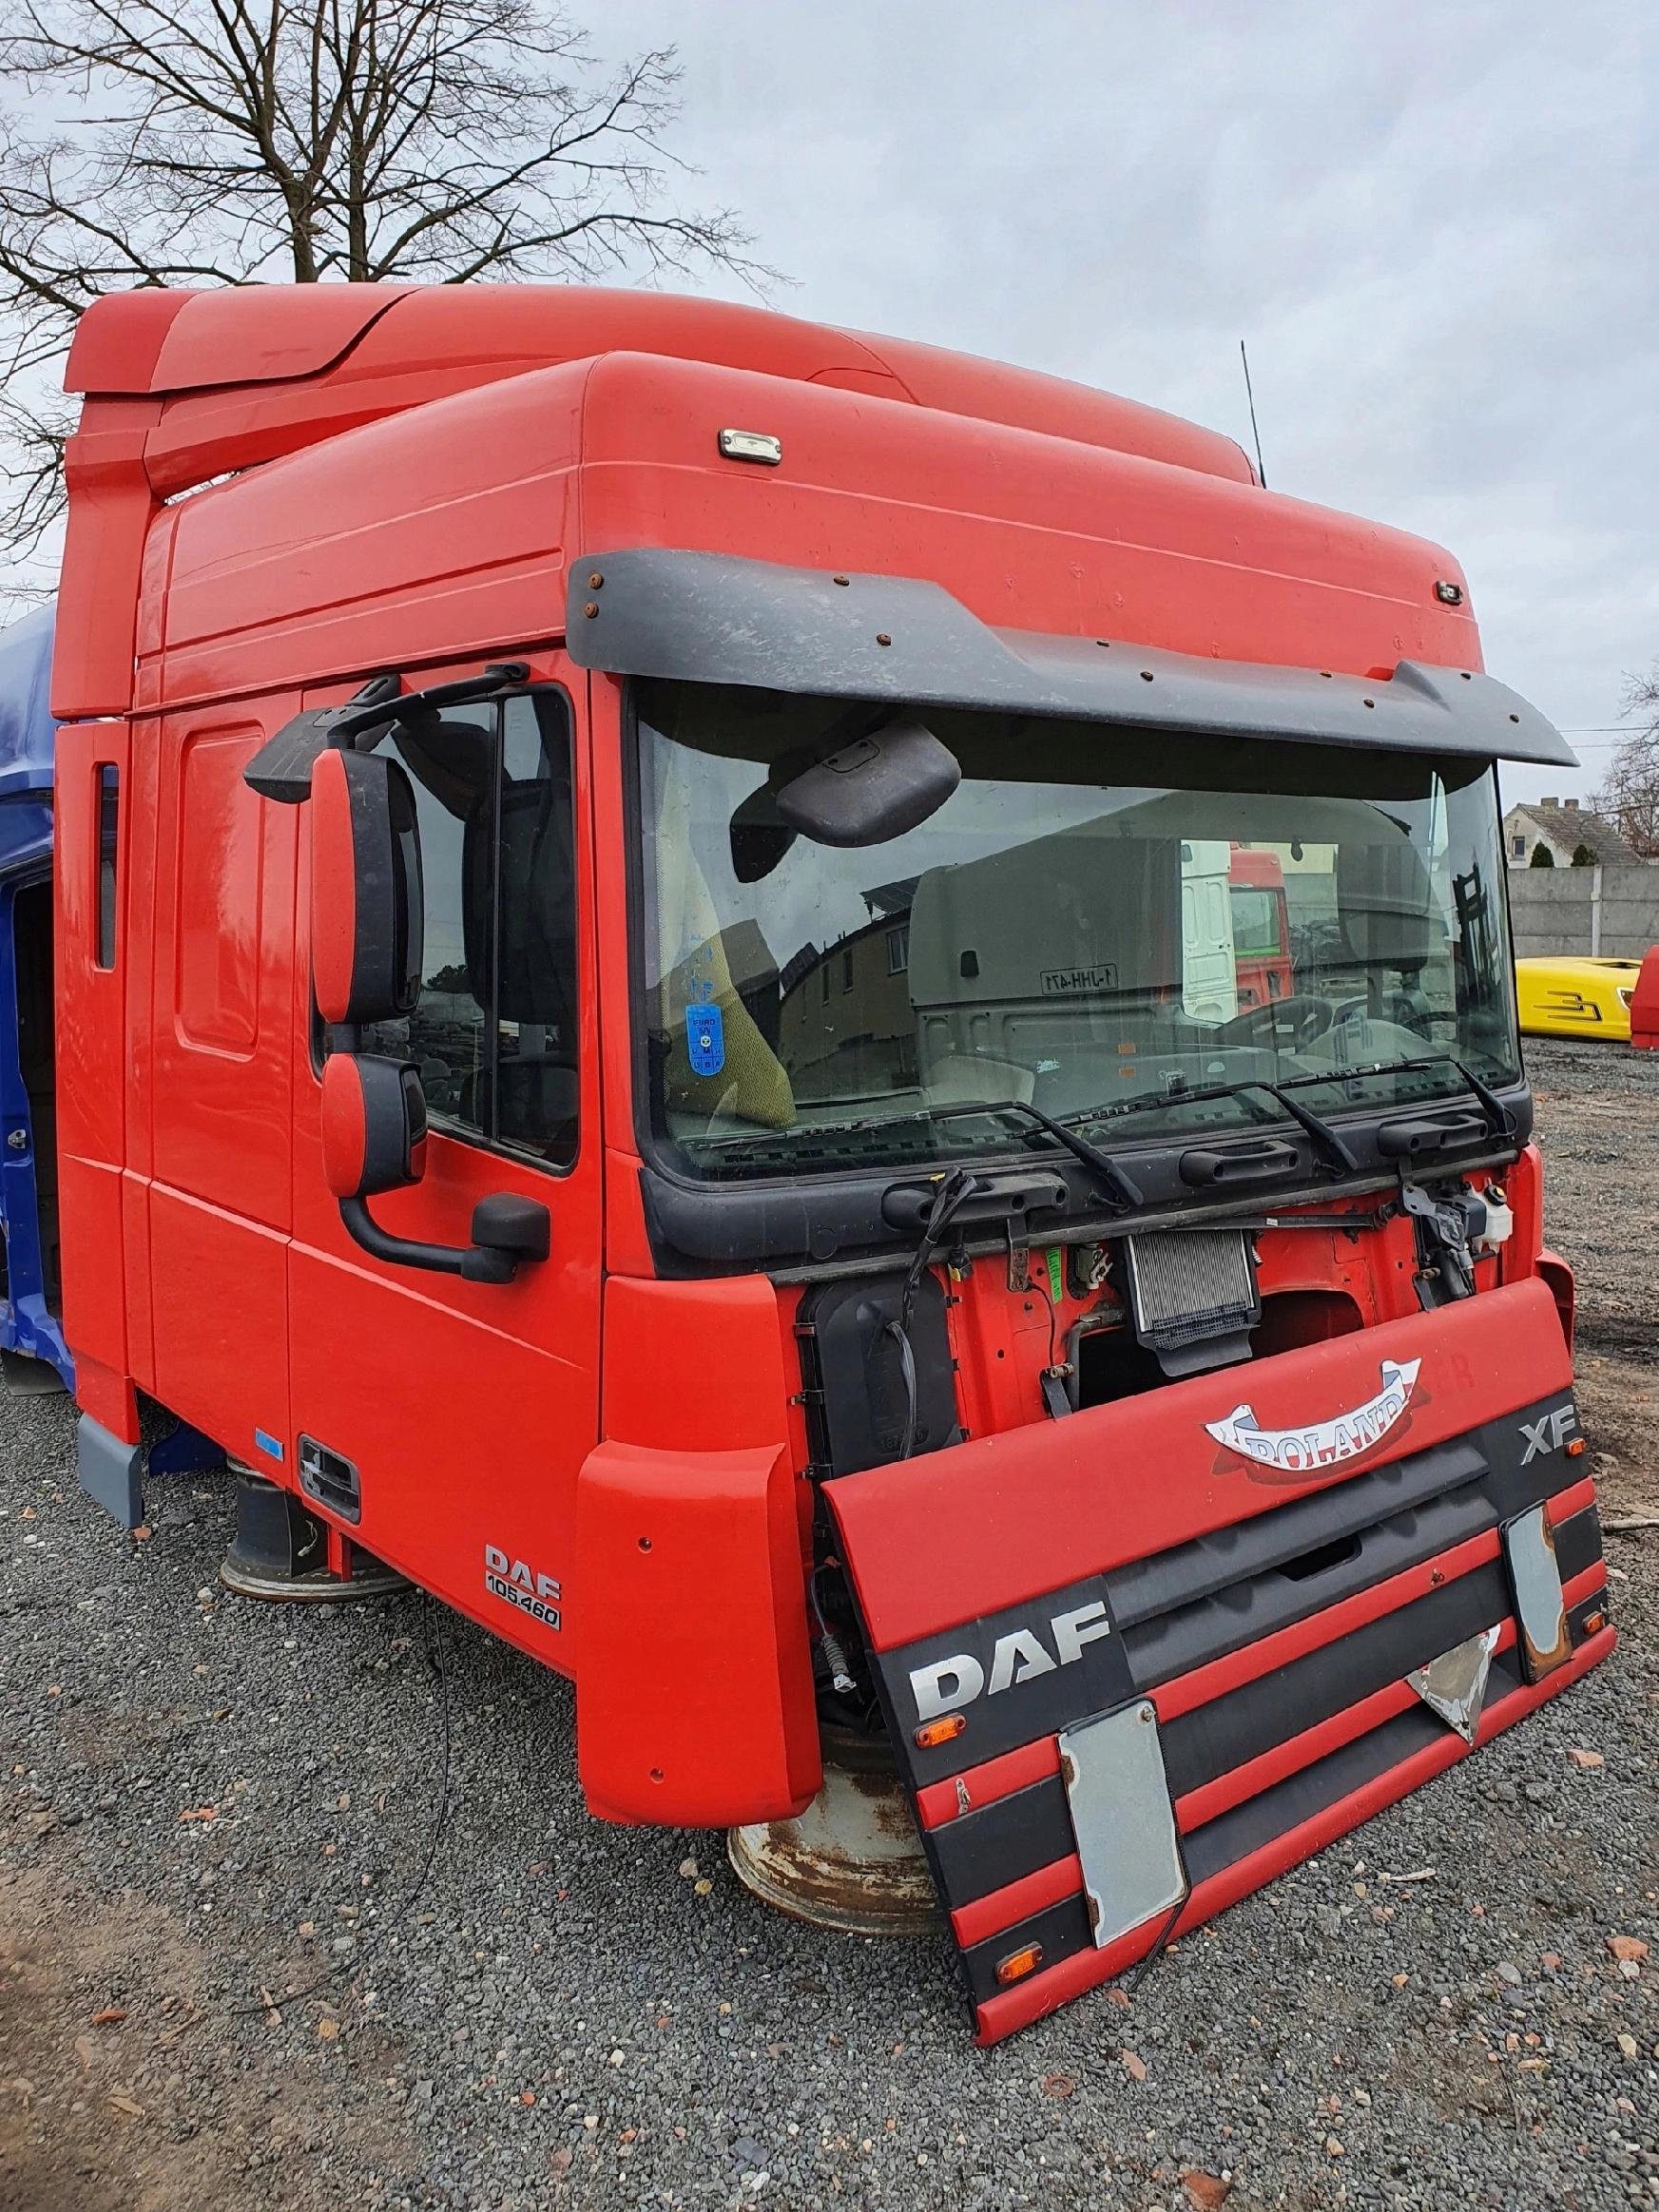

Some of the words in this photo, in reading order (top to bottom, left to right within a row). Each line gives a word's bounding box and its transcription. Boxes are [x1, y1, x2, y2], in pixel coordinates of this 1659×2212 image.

[1246, 1394, 1402, 1467] POLAND
[1517, 1404, 1576, 1466] XF
[486, 1544, 560, 1601] DAF
[488, 1574, 558, 1625] 105.460
[909, 1601, 1110, 1722] DAF
